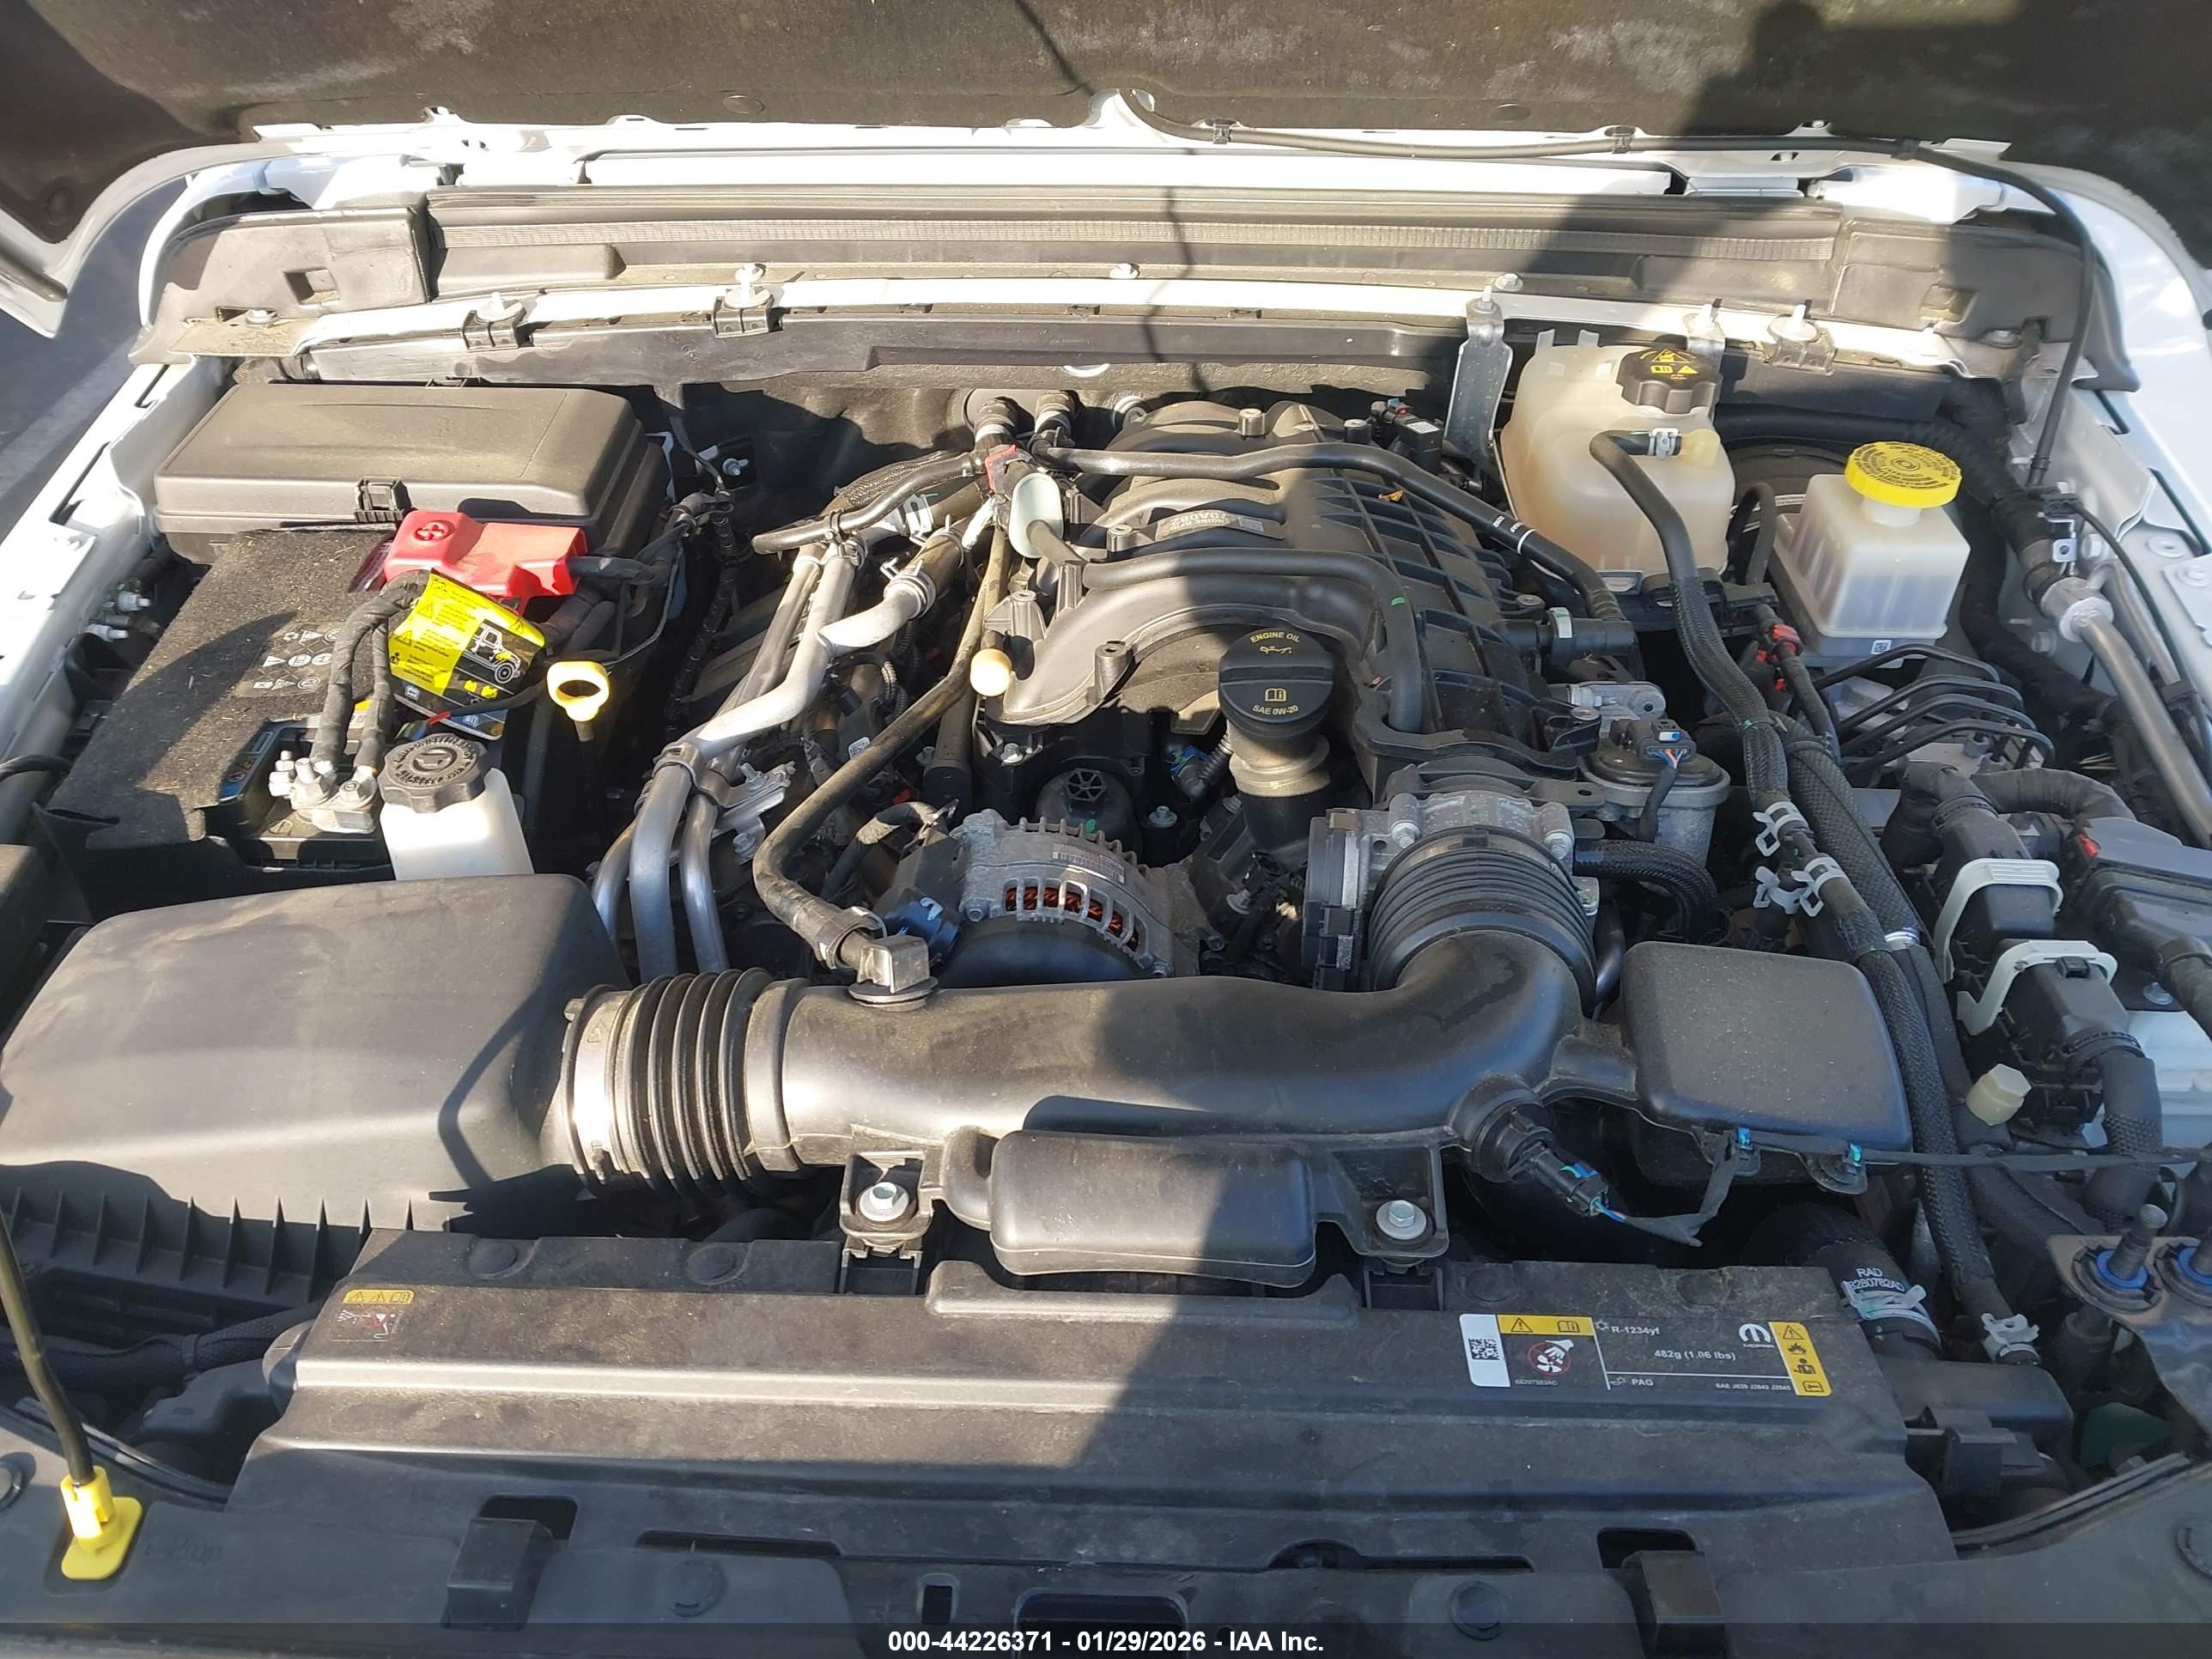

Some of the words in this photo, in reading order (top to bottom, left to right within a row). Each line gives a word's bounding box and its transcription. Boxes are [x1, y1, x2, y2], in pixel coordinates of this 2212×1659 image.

[1249, 631, 1285, 643] ENGINE
[1286, 633, 1300, 642] OIL
[1252, 704, 1272, 715] SAE
[1273, 704, 1299, 715] 0W-20
[1856, 1267, 1883, 1278] RAD
[1612, 1326, 1660, 1336] R-1234yf
[1654, 1349, 1682, 1360] 482g
[1684, 1350, 1711, 1360] (1.06
[1714, 1351, 1736, 1361] lbs)
